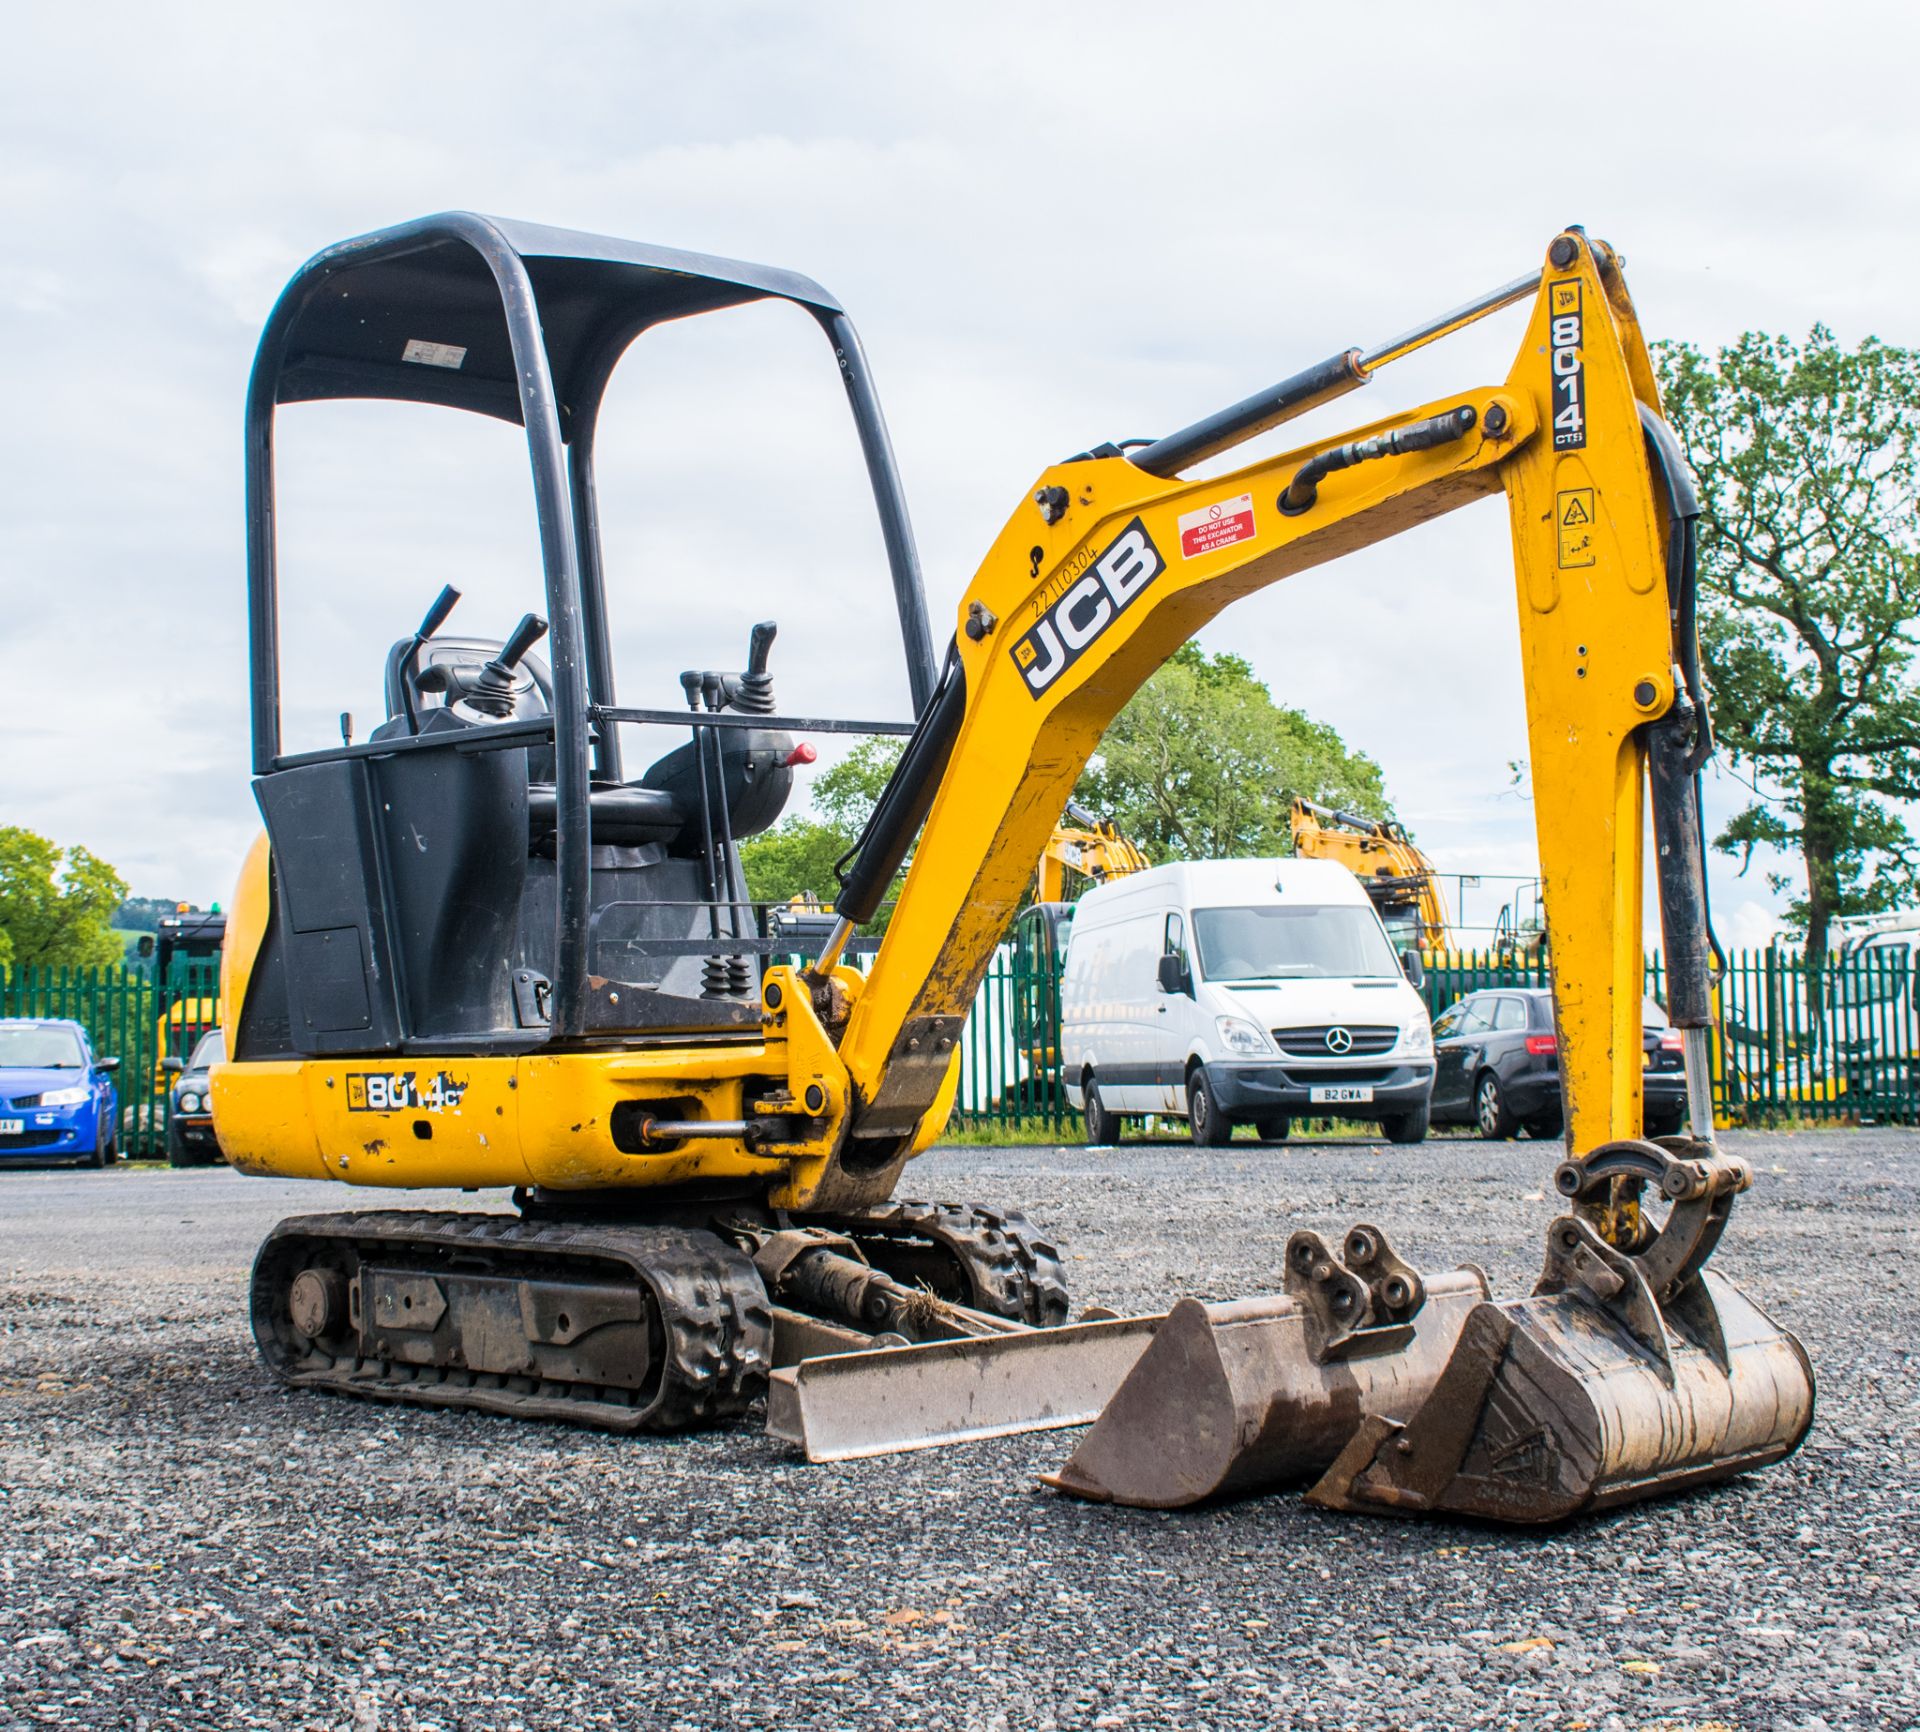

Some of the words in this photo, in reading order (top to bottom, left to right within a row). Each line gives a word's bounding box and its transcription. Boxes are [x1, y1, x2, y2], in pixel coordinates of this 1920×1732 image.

[1557, 290, 1575, 307] JCB
[1552, 316, 1583, 432] 8014
[1555, 432, 1583, 444] CTS
[1192, 536, 1207, 545] THIS
[1207, 523, 1243, 540] EXCAVATOR
[1198, 526, 1208, 534] DO
[1209, 521, 1222, 531] NOT
[1222, 517, 1235, 526] USE
[1200, 543, 1210, 551] AS
[1215, 534, 1237, 546] CRANE
[1031, 545, 1098, 618] 22110304
[1027, 530, 1157, 688] JCB
[1324, 1089, 1339, 1100] B2
[1341, 1089, 1361, 1100] GWA
